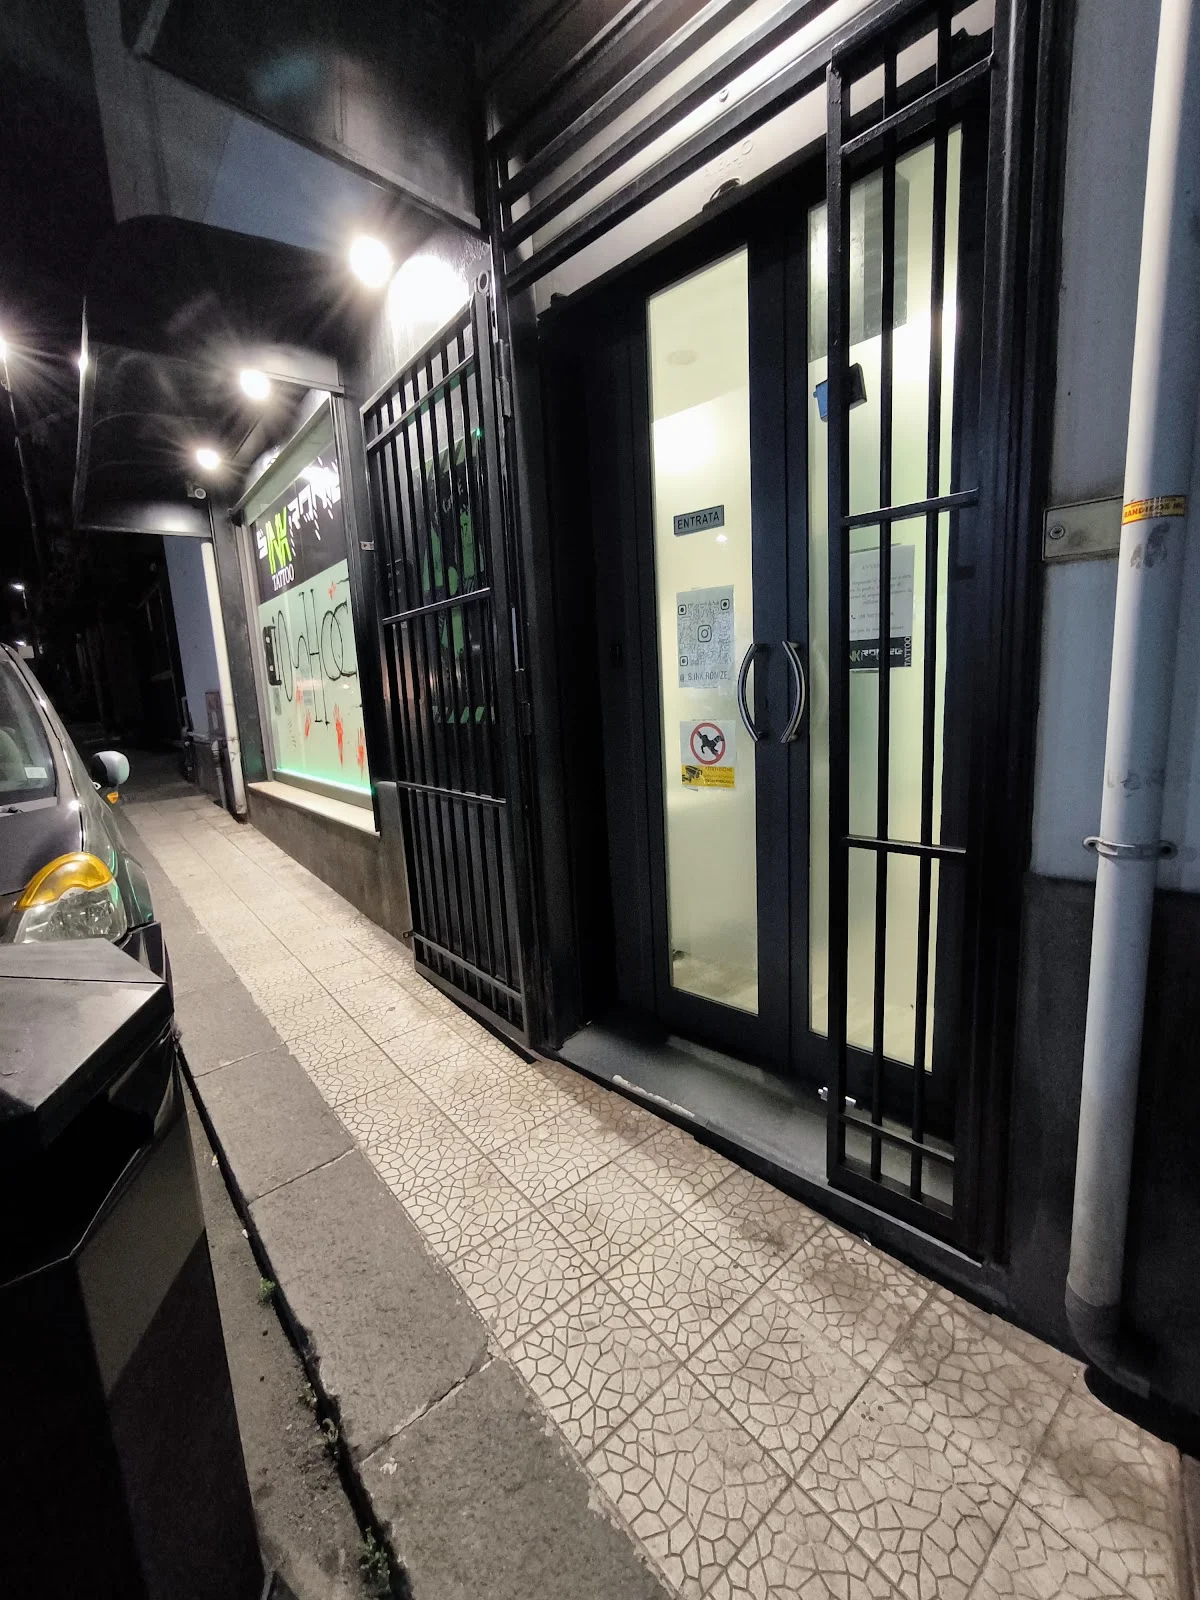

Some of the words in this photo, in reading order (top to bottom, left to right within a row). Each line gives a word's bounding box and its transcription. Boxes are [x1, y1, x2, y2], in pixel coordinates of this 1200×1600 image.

[677, 511, 720, 530] ENTRATA
[272, 563, 295, 592] TATTOO
[904, 636, 912, 666] TATTOO
